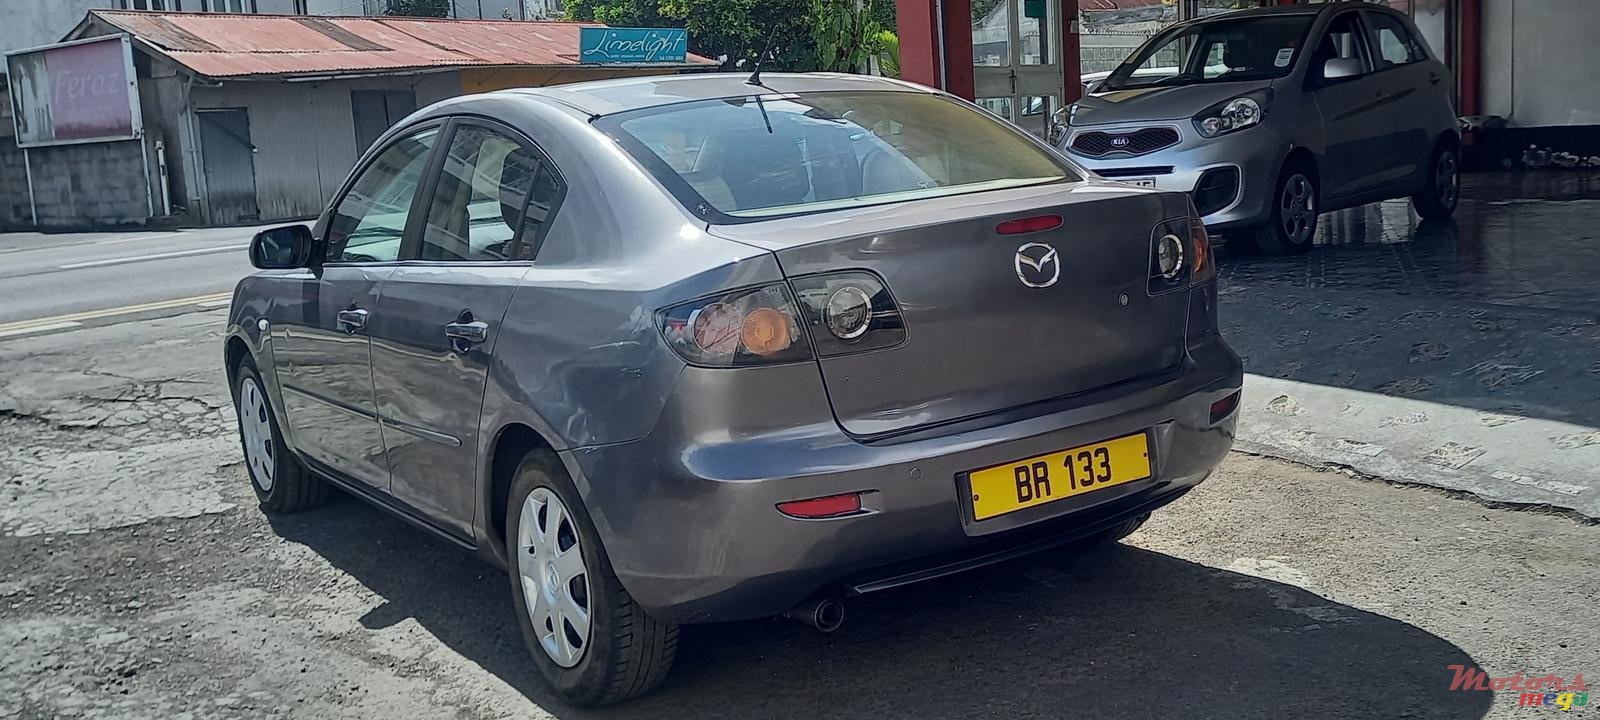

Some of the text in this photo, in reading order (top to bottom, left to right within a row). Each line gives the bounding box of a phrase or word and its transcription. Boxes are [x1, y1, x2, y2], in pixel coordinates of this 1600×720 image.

[583, 30, 684, 61] Limelight
[1014, 447, 1112, 503] BR 133
